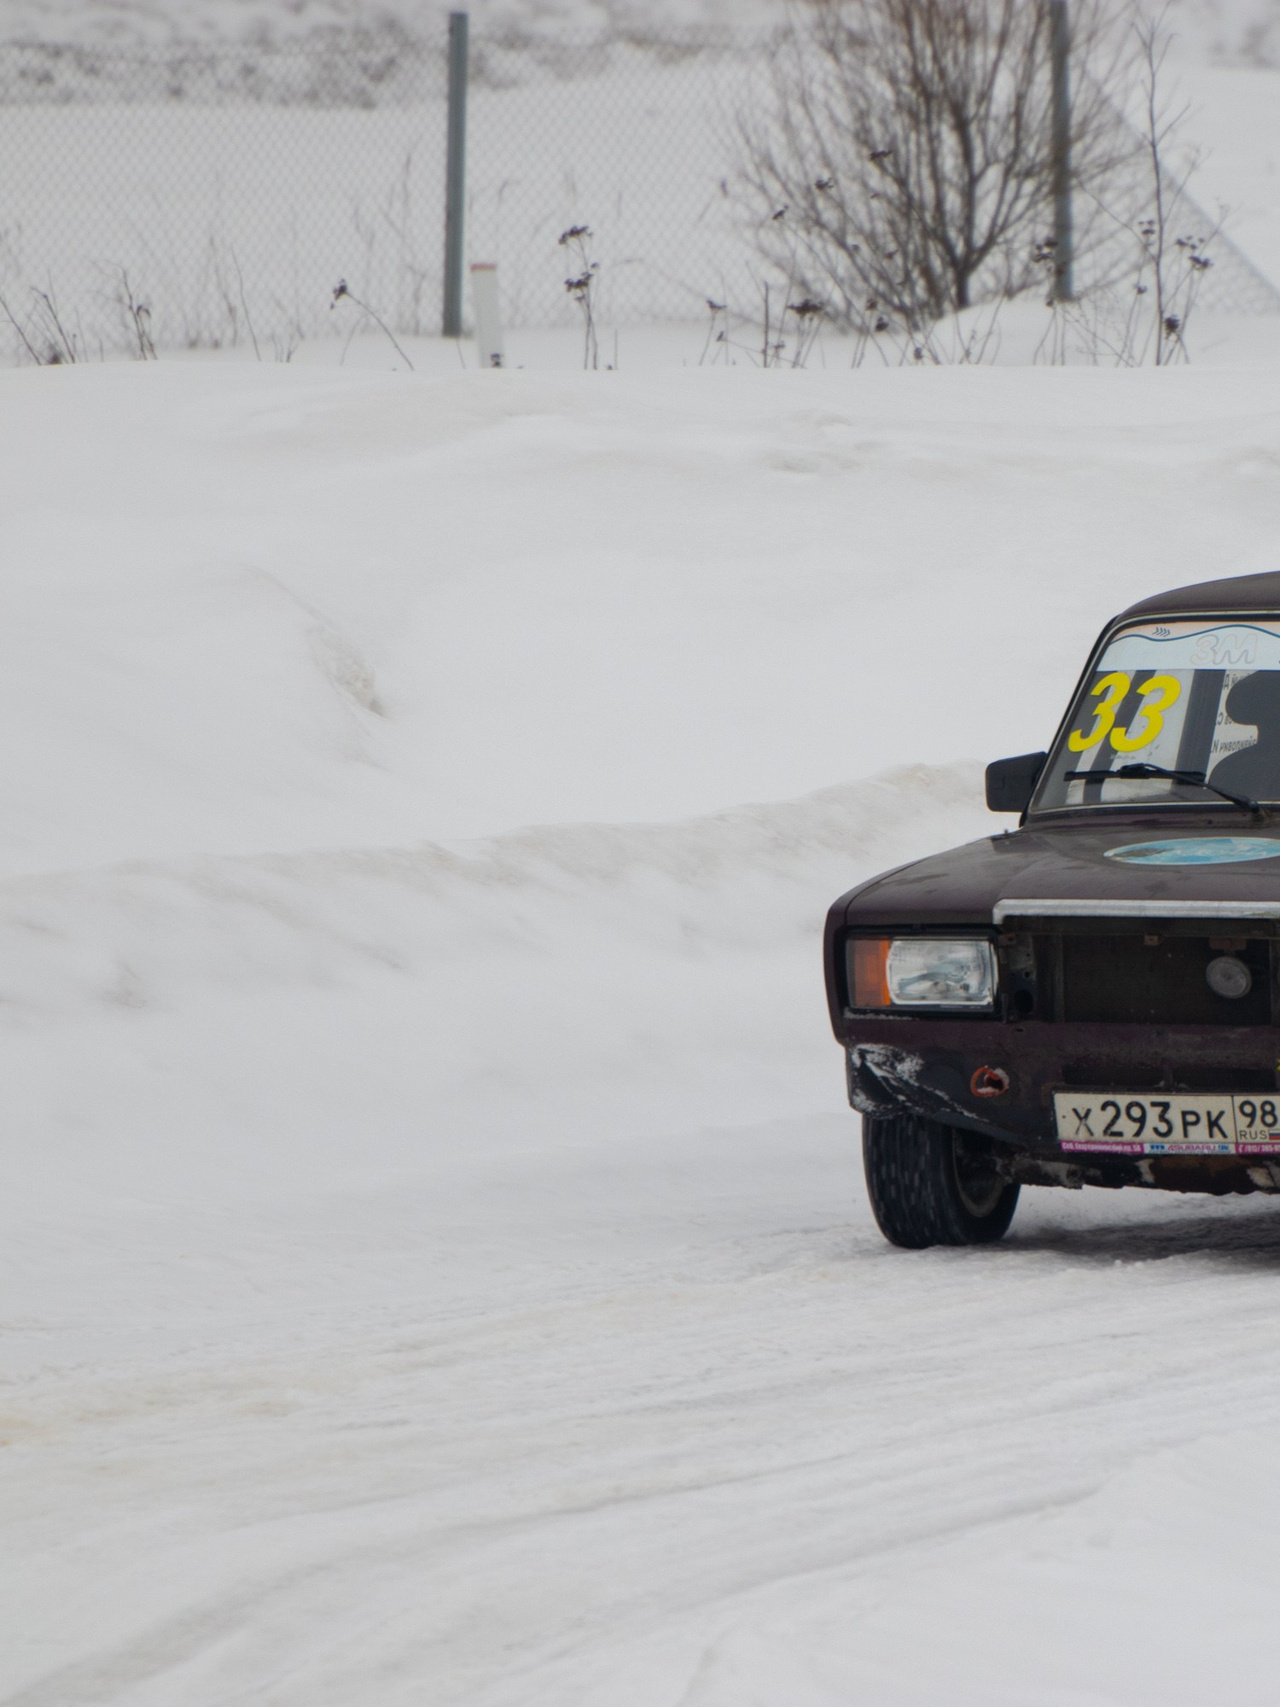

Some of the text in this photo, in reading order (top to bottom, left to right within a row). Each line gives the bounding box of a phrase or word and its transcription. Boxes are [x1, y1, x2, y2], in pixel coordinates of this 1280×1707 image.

[1068, 671, 1182, 753] 33
[1239, 1100, 1279, 1128] 98
[1239, 1130, 1267, 1140] RUS
